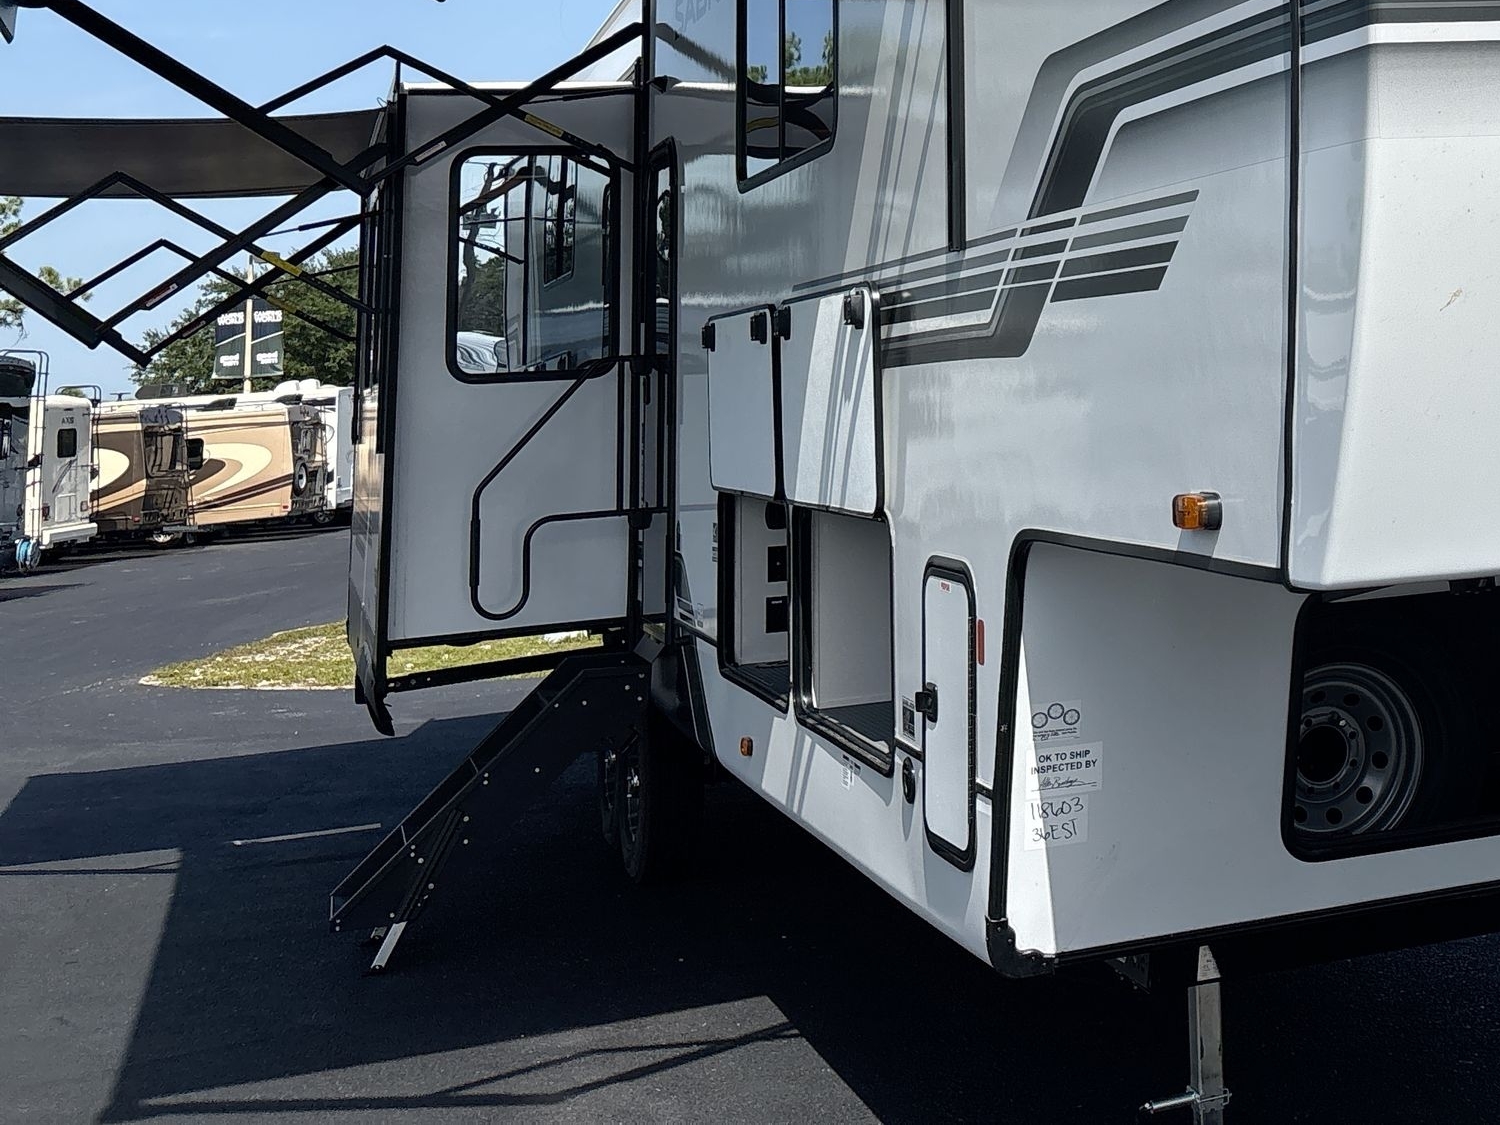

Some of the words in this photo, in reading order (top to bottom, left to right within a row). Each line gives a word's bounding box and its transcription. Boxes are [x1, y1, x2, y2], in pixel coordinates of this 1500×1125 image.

[1038, 754, 1052, 763] OK
[1054, 752, 1067, 762] TO
[1069, 749, 1091, 760] SHIP
[1031, 761, 1083, 775] INSPECTED
[1085, 759, 1098, 769] BY
